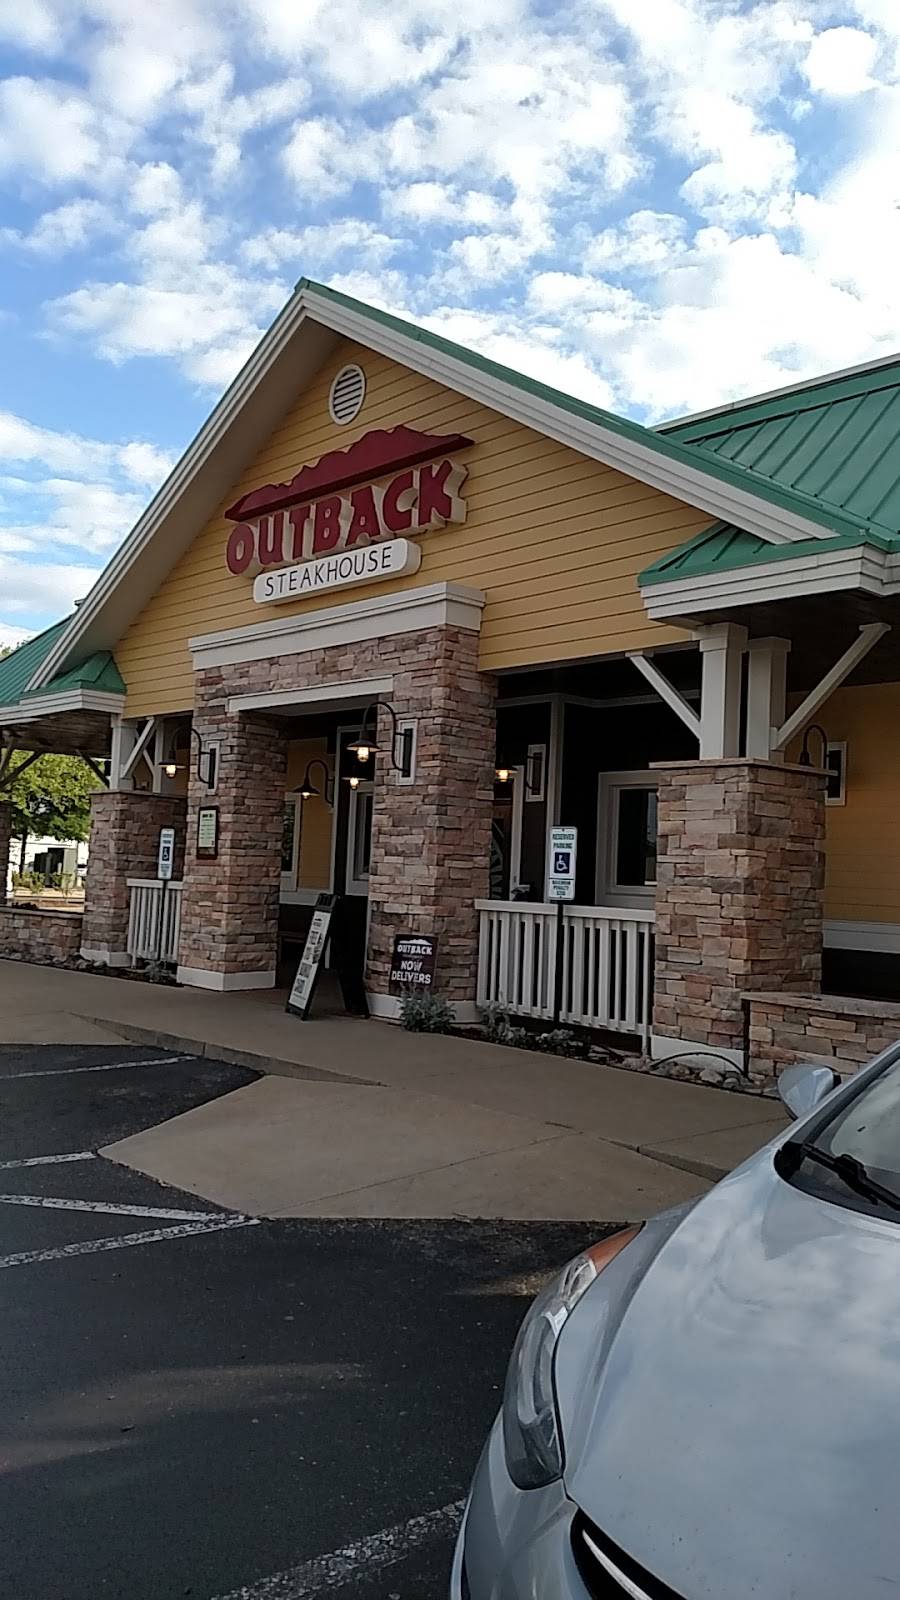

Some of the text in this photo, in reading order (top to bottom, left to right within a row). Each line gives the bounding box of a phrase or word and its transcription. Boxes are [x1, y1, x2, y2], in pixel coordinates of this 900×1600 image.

[226, 459, 464, 576] OUTBACK
[264, 546, 393, 597] STEAKHOUSE
[397, 944, 433, 955] OUTBACK
[400, 960, 423, 971] NOW
[391, 970, 432, 984] DELIVERS
